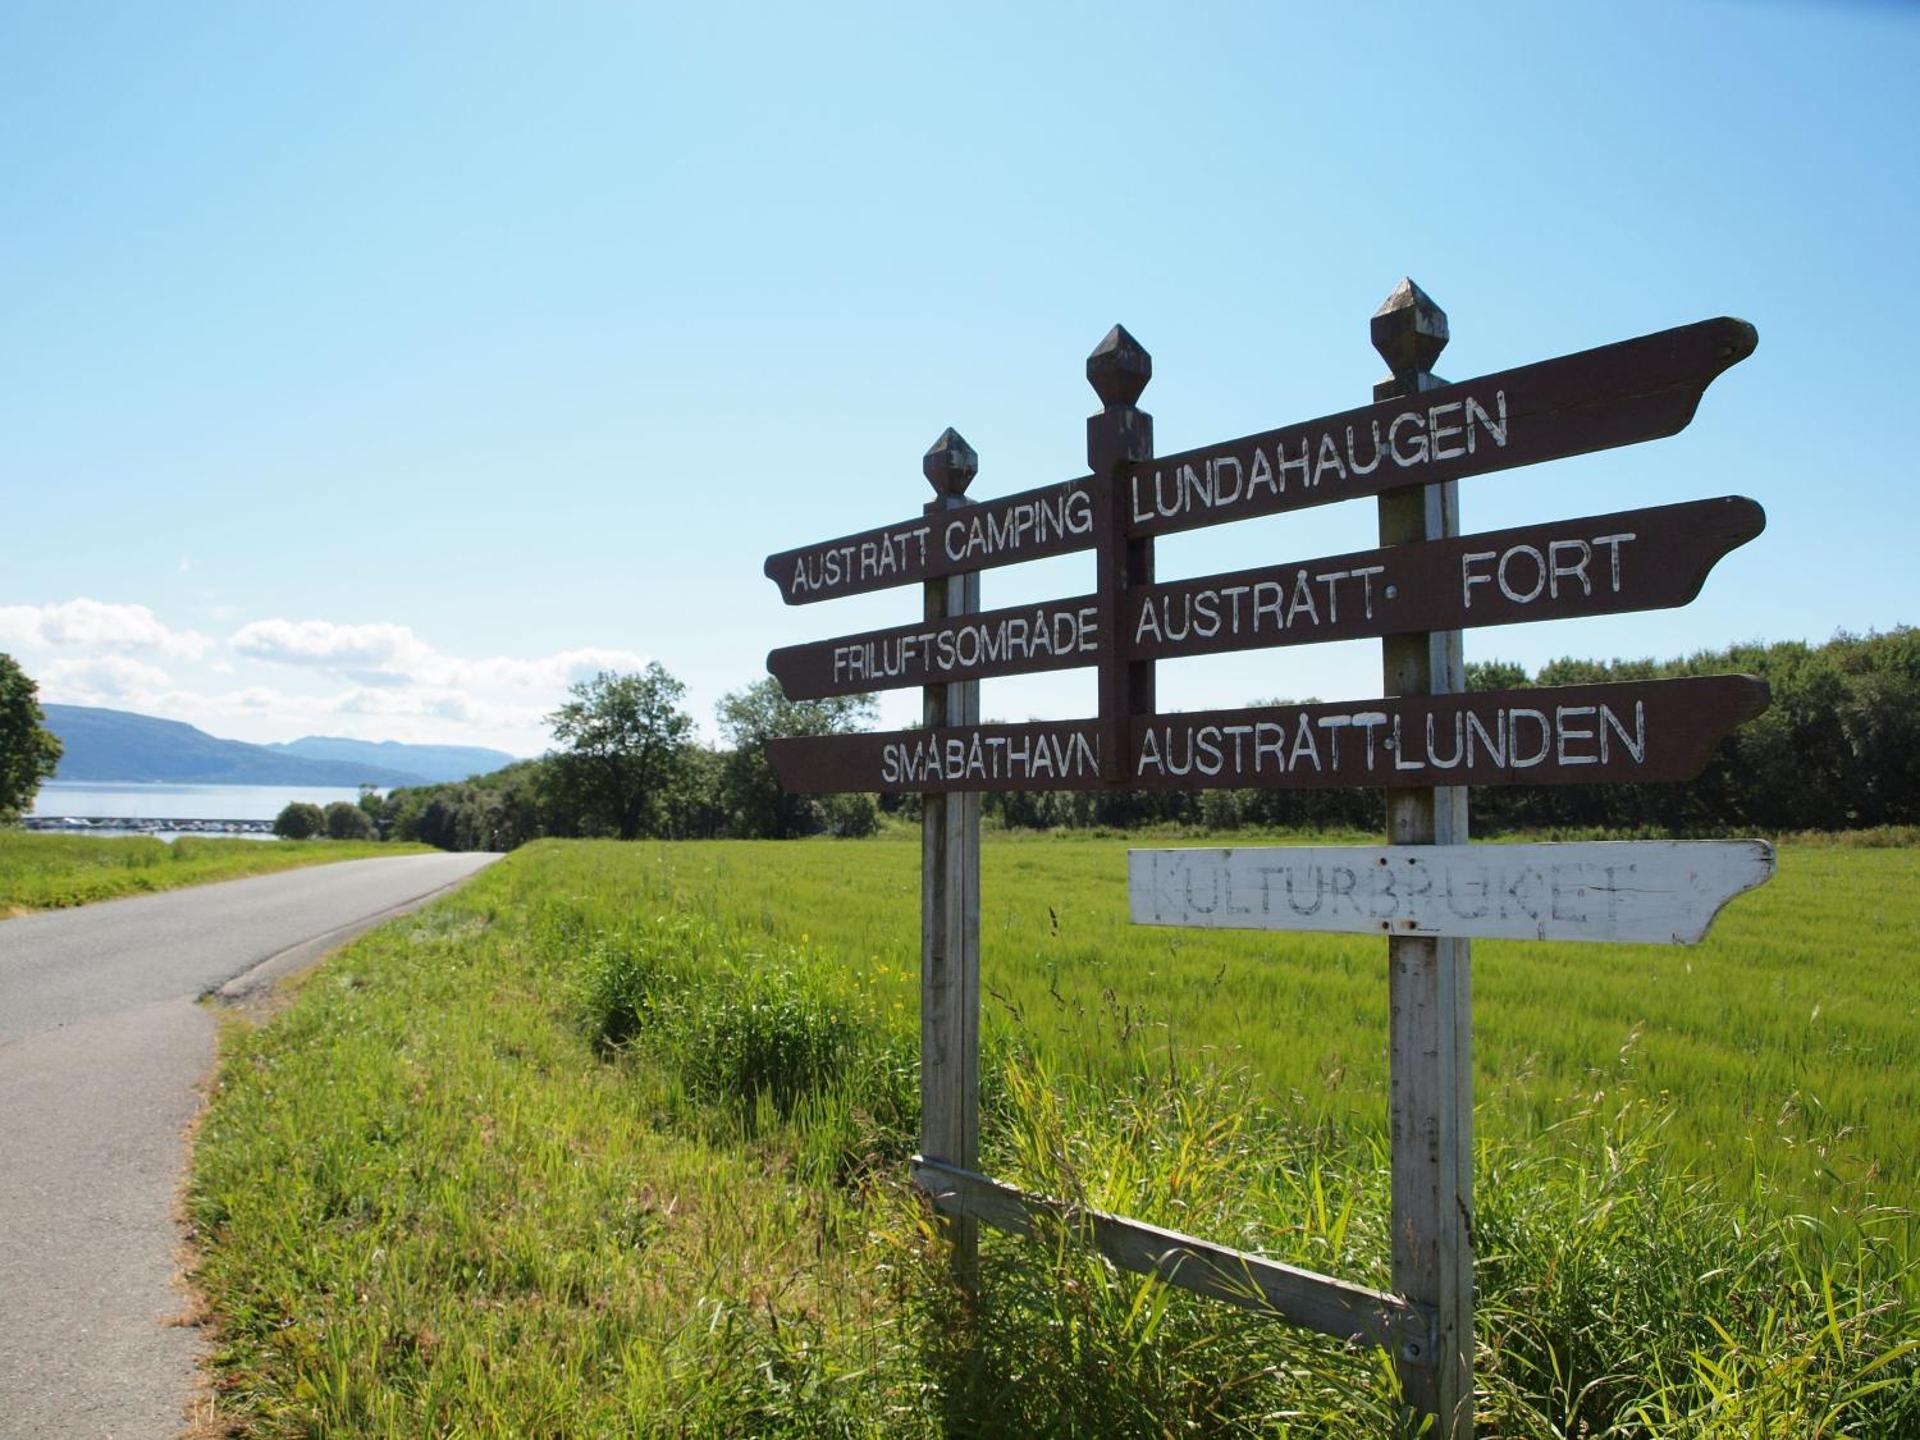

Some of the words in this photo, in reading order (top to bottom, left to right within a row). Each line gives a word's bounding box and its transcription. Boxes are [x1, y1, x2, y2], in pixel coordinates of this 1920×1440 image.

[1131, 389, 1509, 524] LUNDAHAUGEN
[791, 526, 931, 594] AUSTRÅTT
[945, 490, 1093, 562] CAMPING
[1135, 566, 1385, 644] AUSTRÅTT
[1462, 532, 1637, 608] FORT
[833, 606, 1099, 683] FRILUFTSOMRÅDE
[881, 731, 1100, 784] SMÅBÅTHAVN
